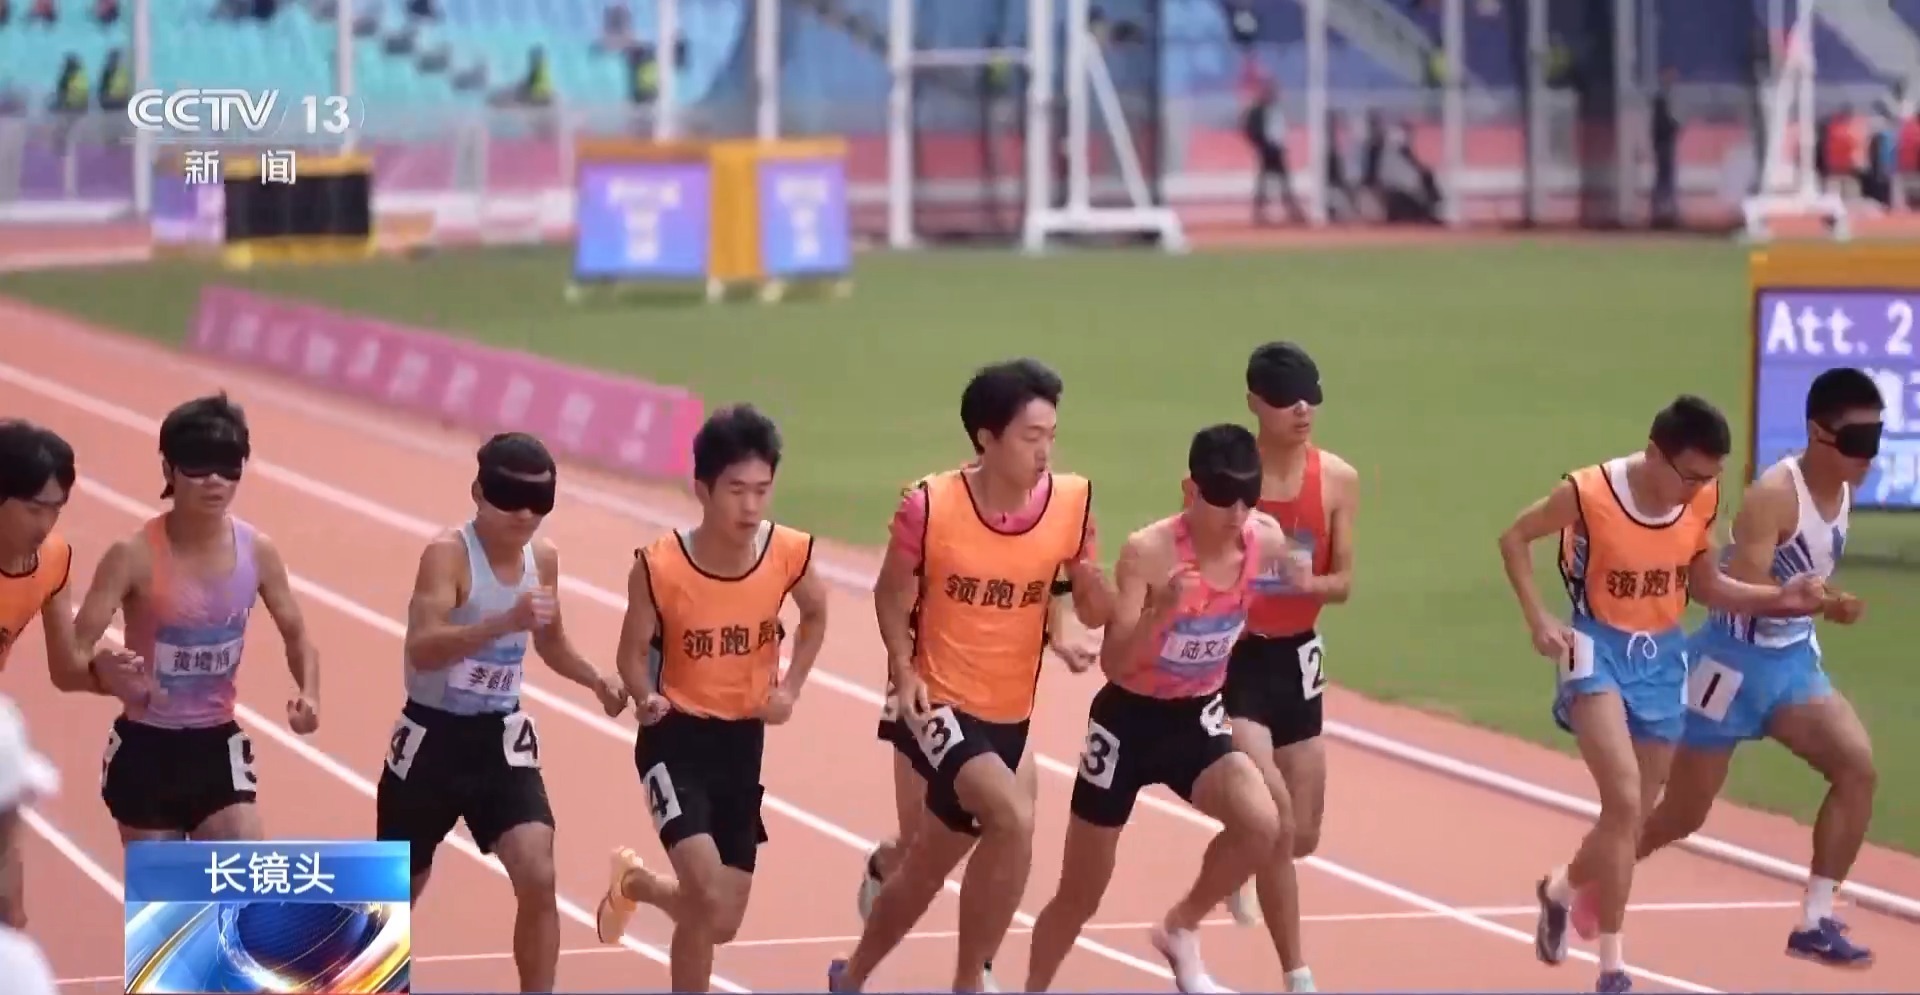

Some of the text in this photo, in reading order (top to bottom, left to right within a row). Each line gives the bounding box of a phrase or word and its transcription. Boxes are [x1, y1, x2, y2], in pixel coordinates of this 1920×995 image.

[1766, 300, 1914, 355] Att. 2
[944, 573, 1046, 611] 领跑员
[1307, 645, 1327, 690] 2
[1700, 672, 1722, 709] 1
[390, 725, 411, 767] 4
[513, 719, 539, 760] 4
[924, 716, 952, 755] 3
[1083, 732, 1111, 777] 3
[648, 774, 669, 819] 4
